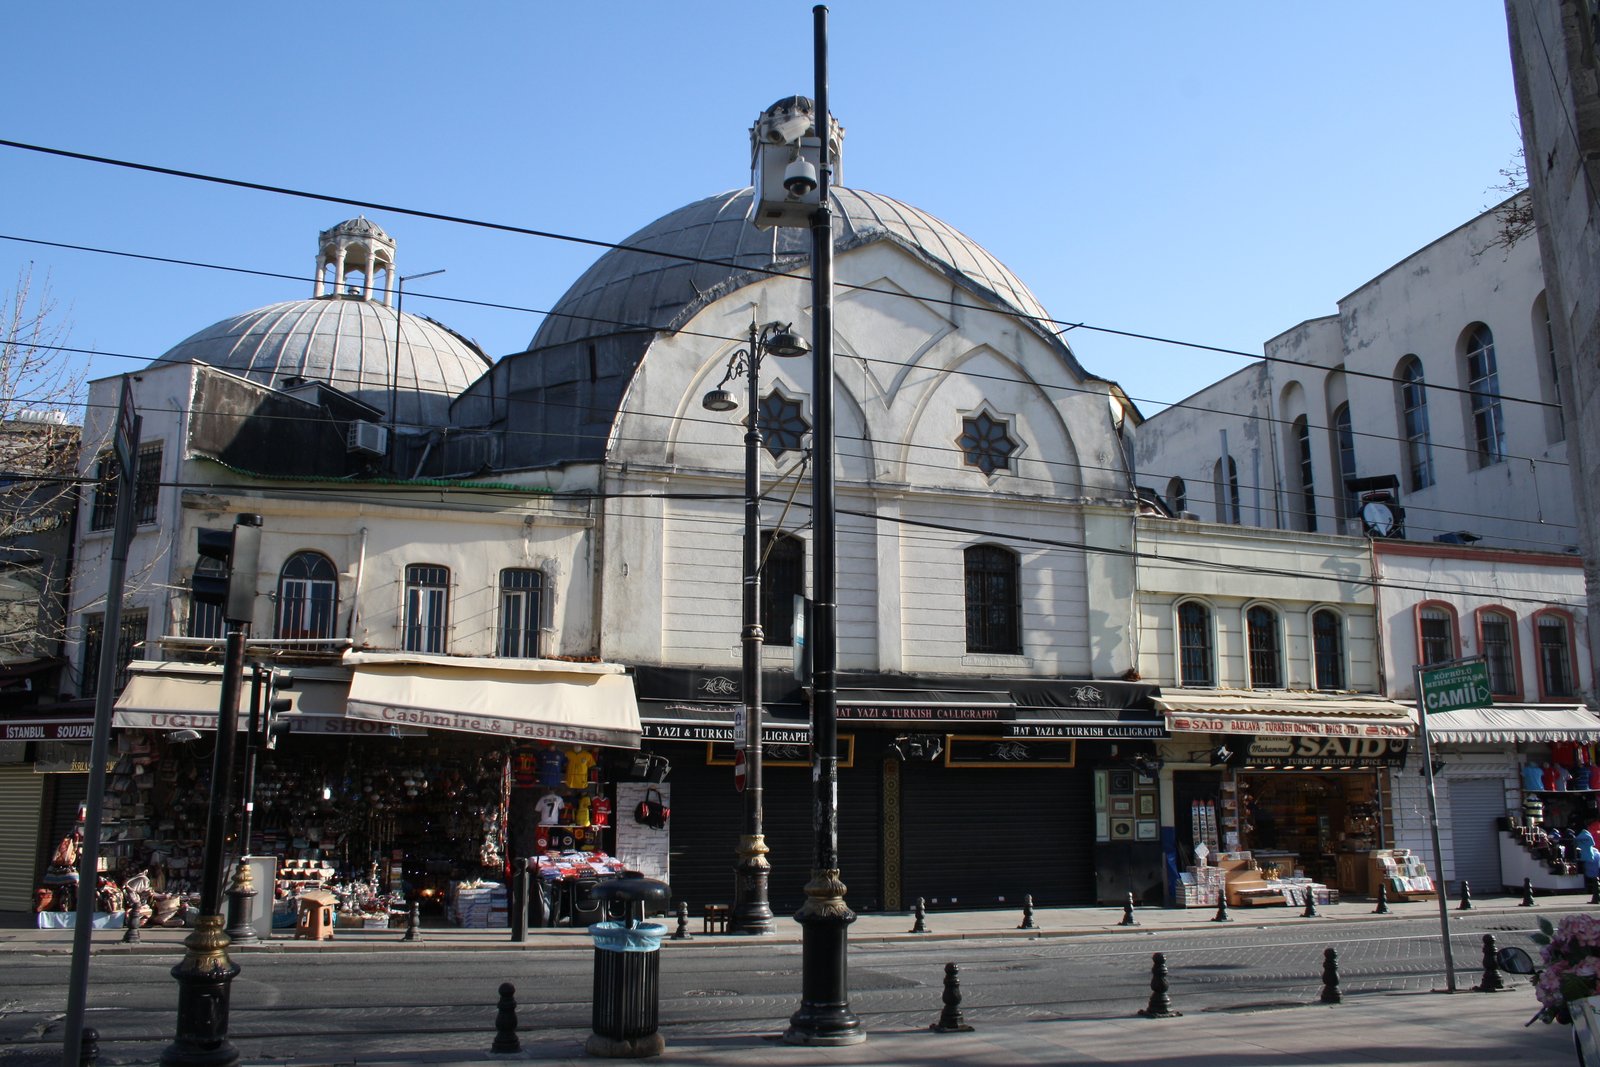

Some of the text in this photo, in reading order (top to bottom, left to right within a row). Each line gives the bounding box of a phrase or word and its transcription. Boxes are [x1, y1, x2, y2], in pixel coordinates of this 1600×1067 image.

[881, 709, 888, 718] &
[891, 708, 932, 719] TURKISH
[937, 709, 999, 719] CALLIGRAPHY
[382, 706, 609, 742] Cashmire & Pashmina
[1192, 720, 1224, 730] SAID
[1231, 721, 1260, 732] BAKLAVA
[1265, 722, 1293, 733] TURKISH
[1346, 726, 1359, 735] TEA
[6, 725, 46, 738] İSTANBUL
[657, 726, 680, 737] YAZI
[683, 728, 691, 737] &
[1013, 726, 1030, 736] HAT
[1065, 727, 1103, 736] TURKISH
[1107, 727, 1164, 737] CALLIGRAPHY
[1381, 725, 1409, 737] SAID
[1297, 737, 1387, 757] SAID
[1288, 758, 1321, 766] TURKISH
[1323, 758, 1356, 766] DELIGHT
[1361, 758, 1381, 766] SPICE
[546, 802, 556, 818] 7
